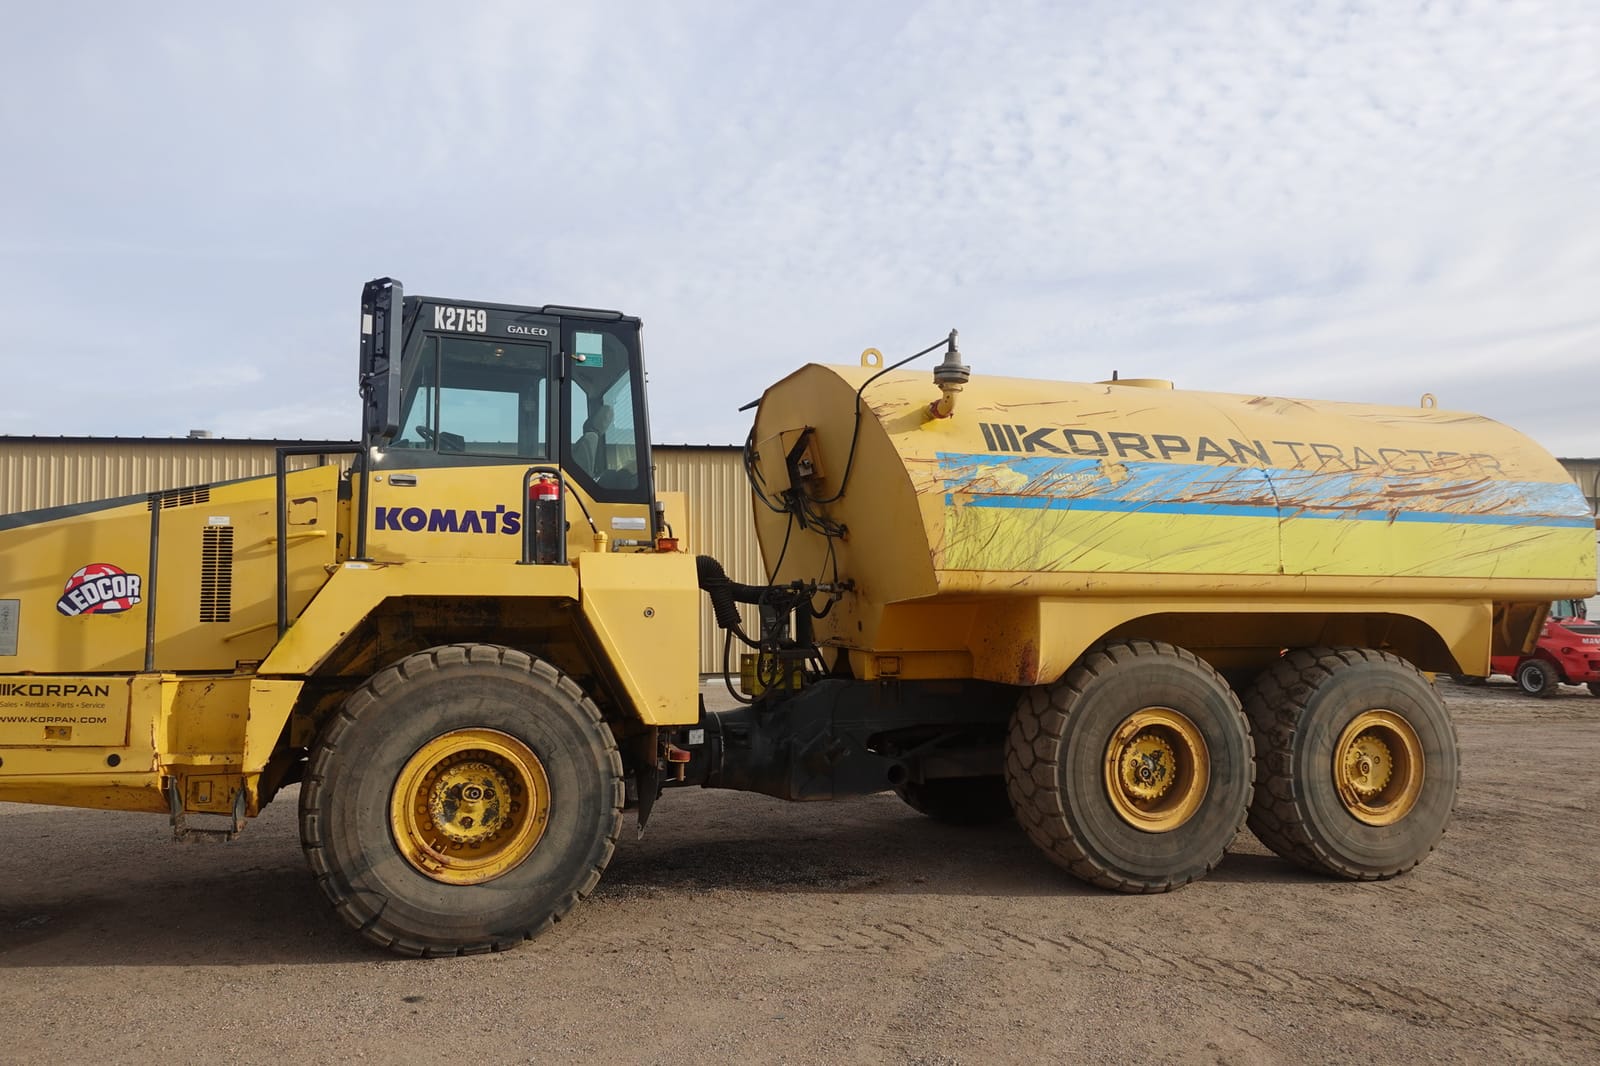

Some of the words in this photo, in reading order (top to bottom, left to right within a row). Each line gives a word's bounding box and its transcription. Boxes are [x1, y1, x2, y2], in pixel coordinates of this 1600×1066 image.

[434, 306, 487, 333] K2759
[507, 325, 548, 336] GALEO
[1014, 425, 1272, 465] KORPAN
[375, 504, 521, 535] KOMATS
[57, 575, 141, 616] LEDCOR
[11, 684, 110, 697] KORPAN
[25, 701, 50, 709] Rentals
[56, 701, 74, 709] Parts
[81, 701, 106, 709] Service
